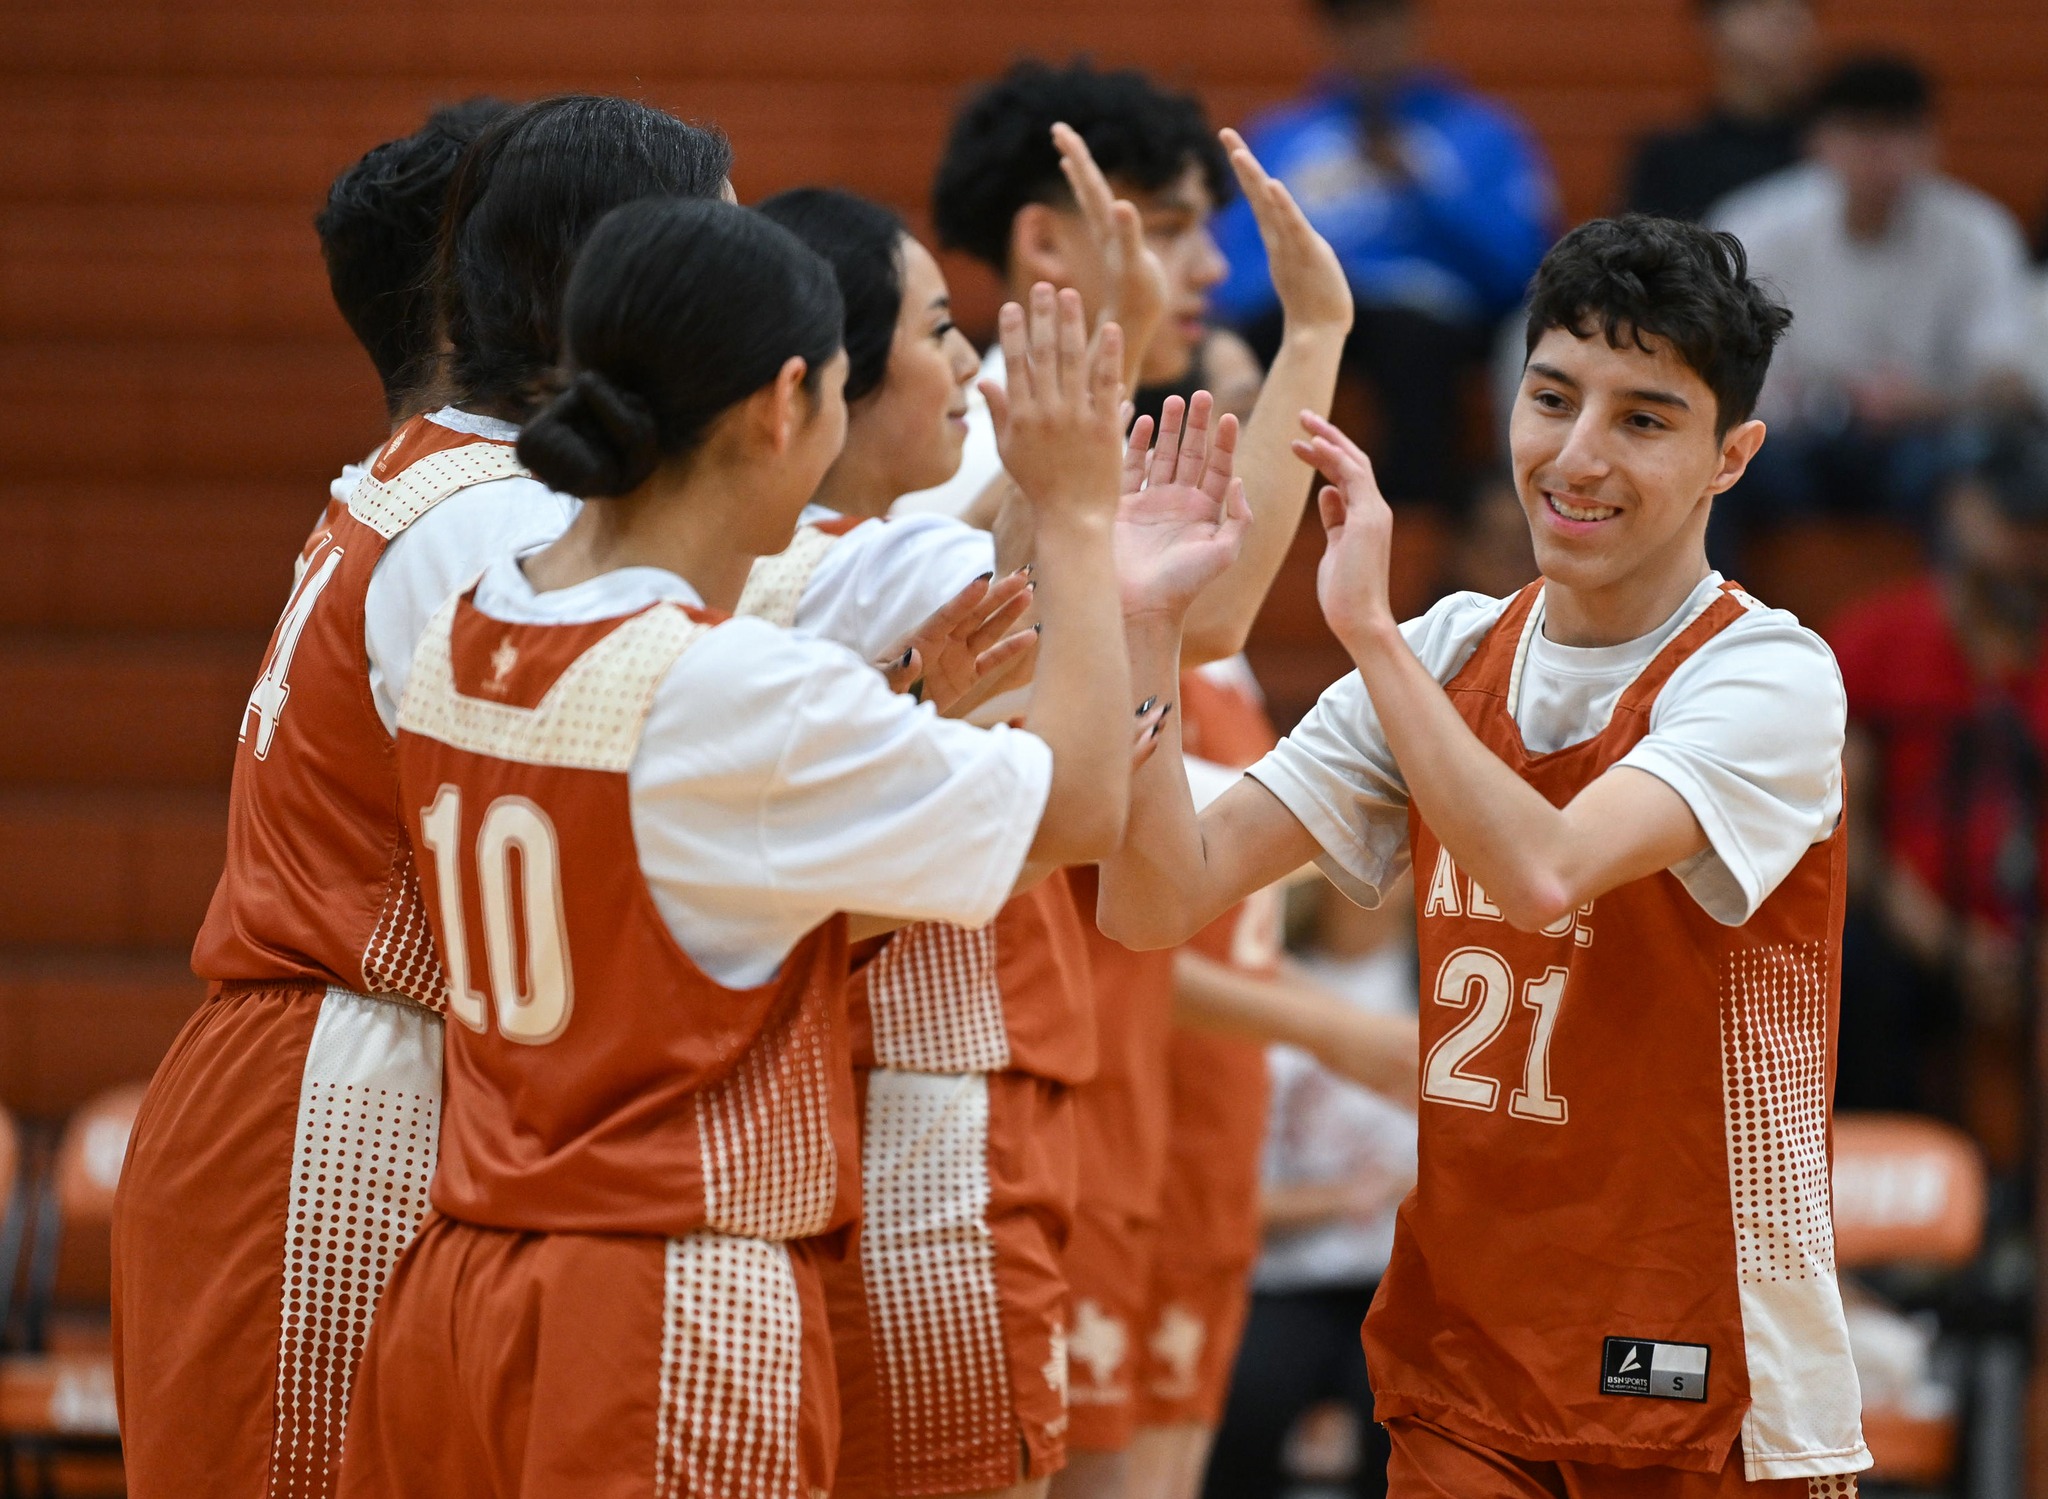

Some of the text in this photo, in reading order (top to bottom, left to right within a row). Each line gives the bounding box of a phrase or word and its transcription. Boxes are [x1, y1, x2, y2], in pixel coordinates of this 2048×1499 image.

[238, 530, 345, 762] 4
[420, 783, 575, 1046] 10
[1422, 945, 1570, 1125] 21
[1672, 1376, 1684, 1391] S
